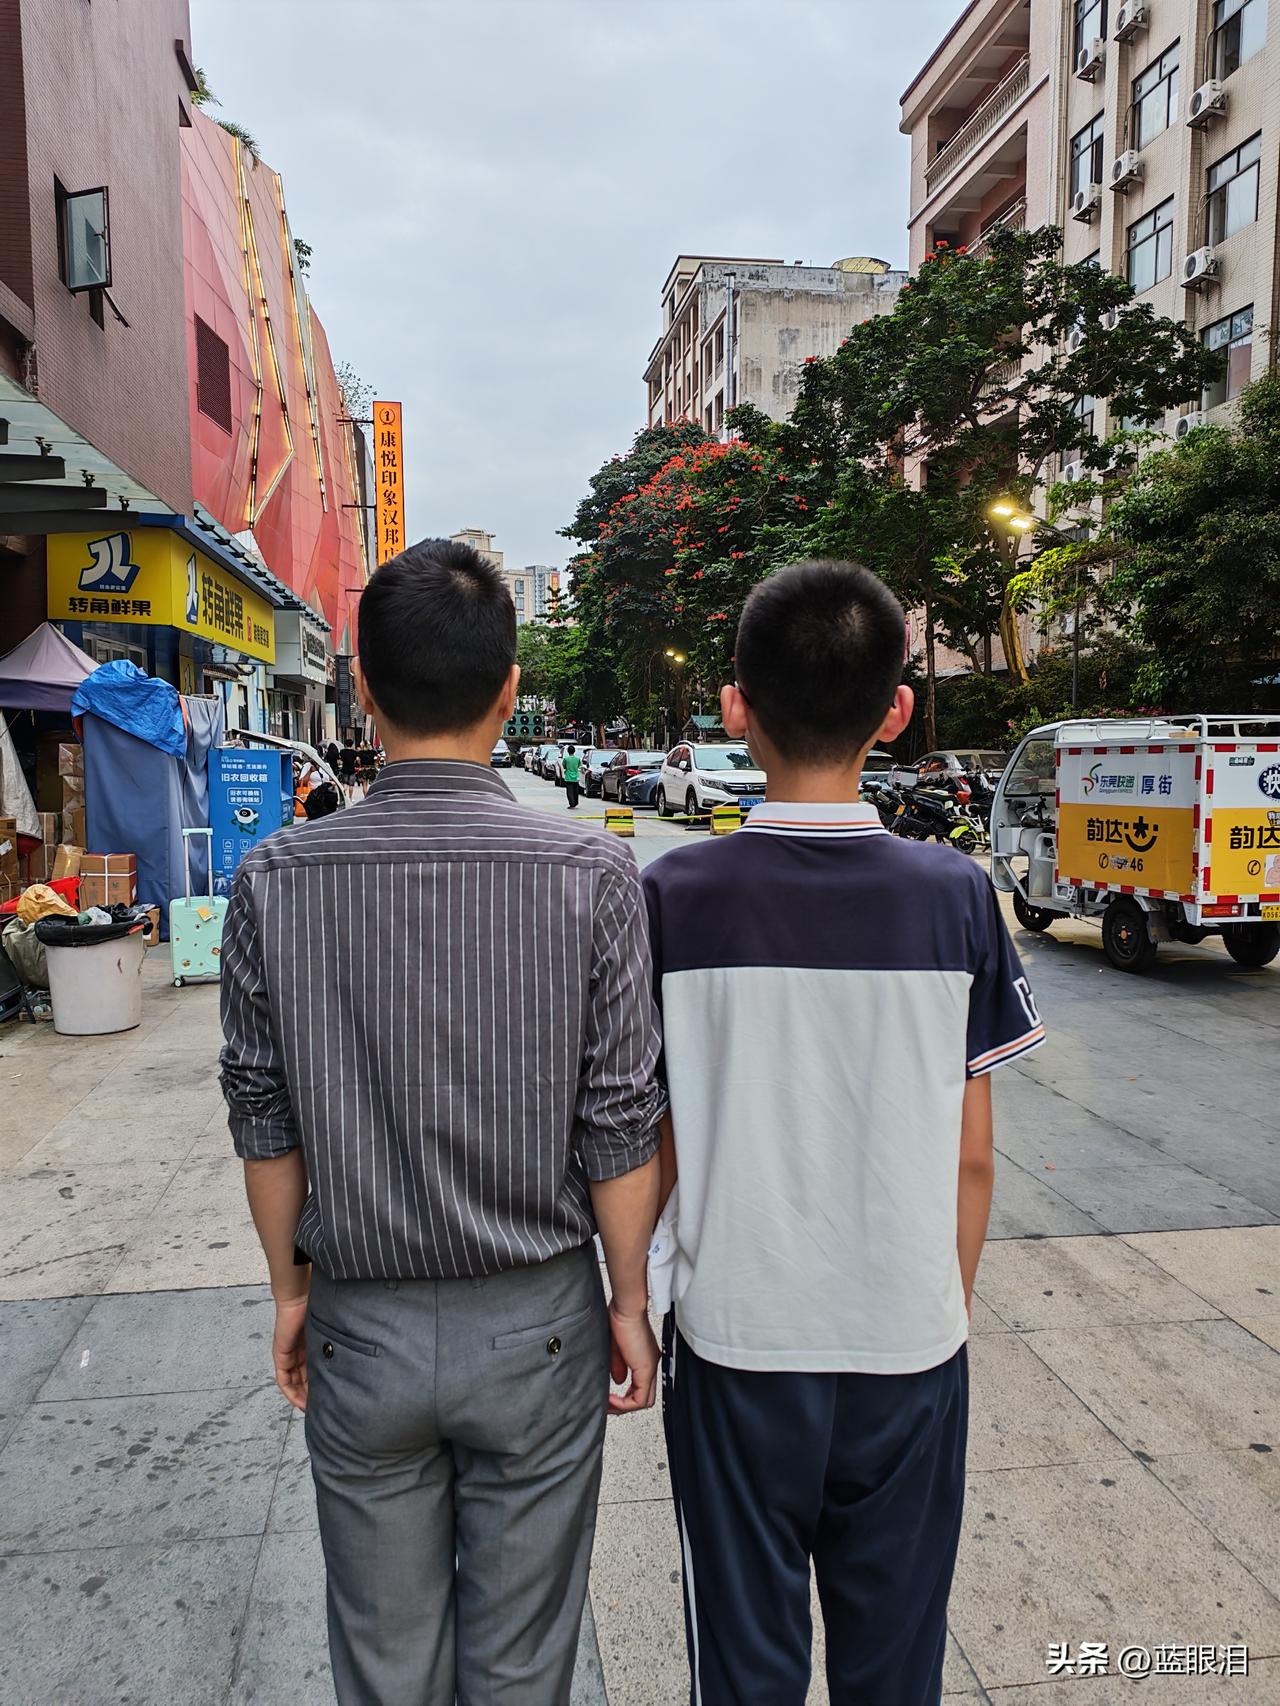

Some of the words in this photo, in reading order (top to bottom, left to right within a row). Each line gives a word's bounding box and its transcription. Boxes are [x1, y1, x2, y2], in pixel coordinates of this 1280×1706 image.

[69, 597, 151, 616] 转角鲜果
[202, 572, 243, 640] 转角鲜果
[221, 773, 268, 783] 旧衣回收箱
[1100, 775, 1135, 788] 东莞快递
[1141, 775, 1173, 795] 厚街
[1087, 818, 1123, 843] 韵达
[1230, 826, 1280, 849] 韵达
